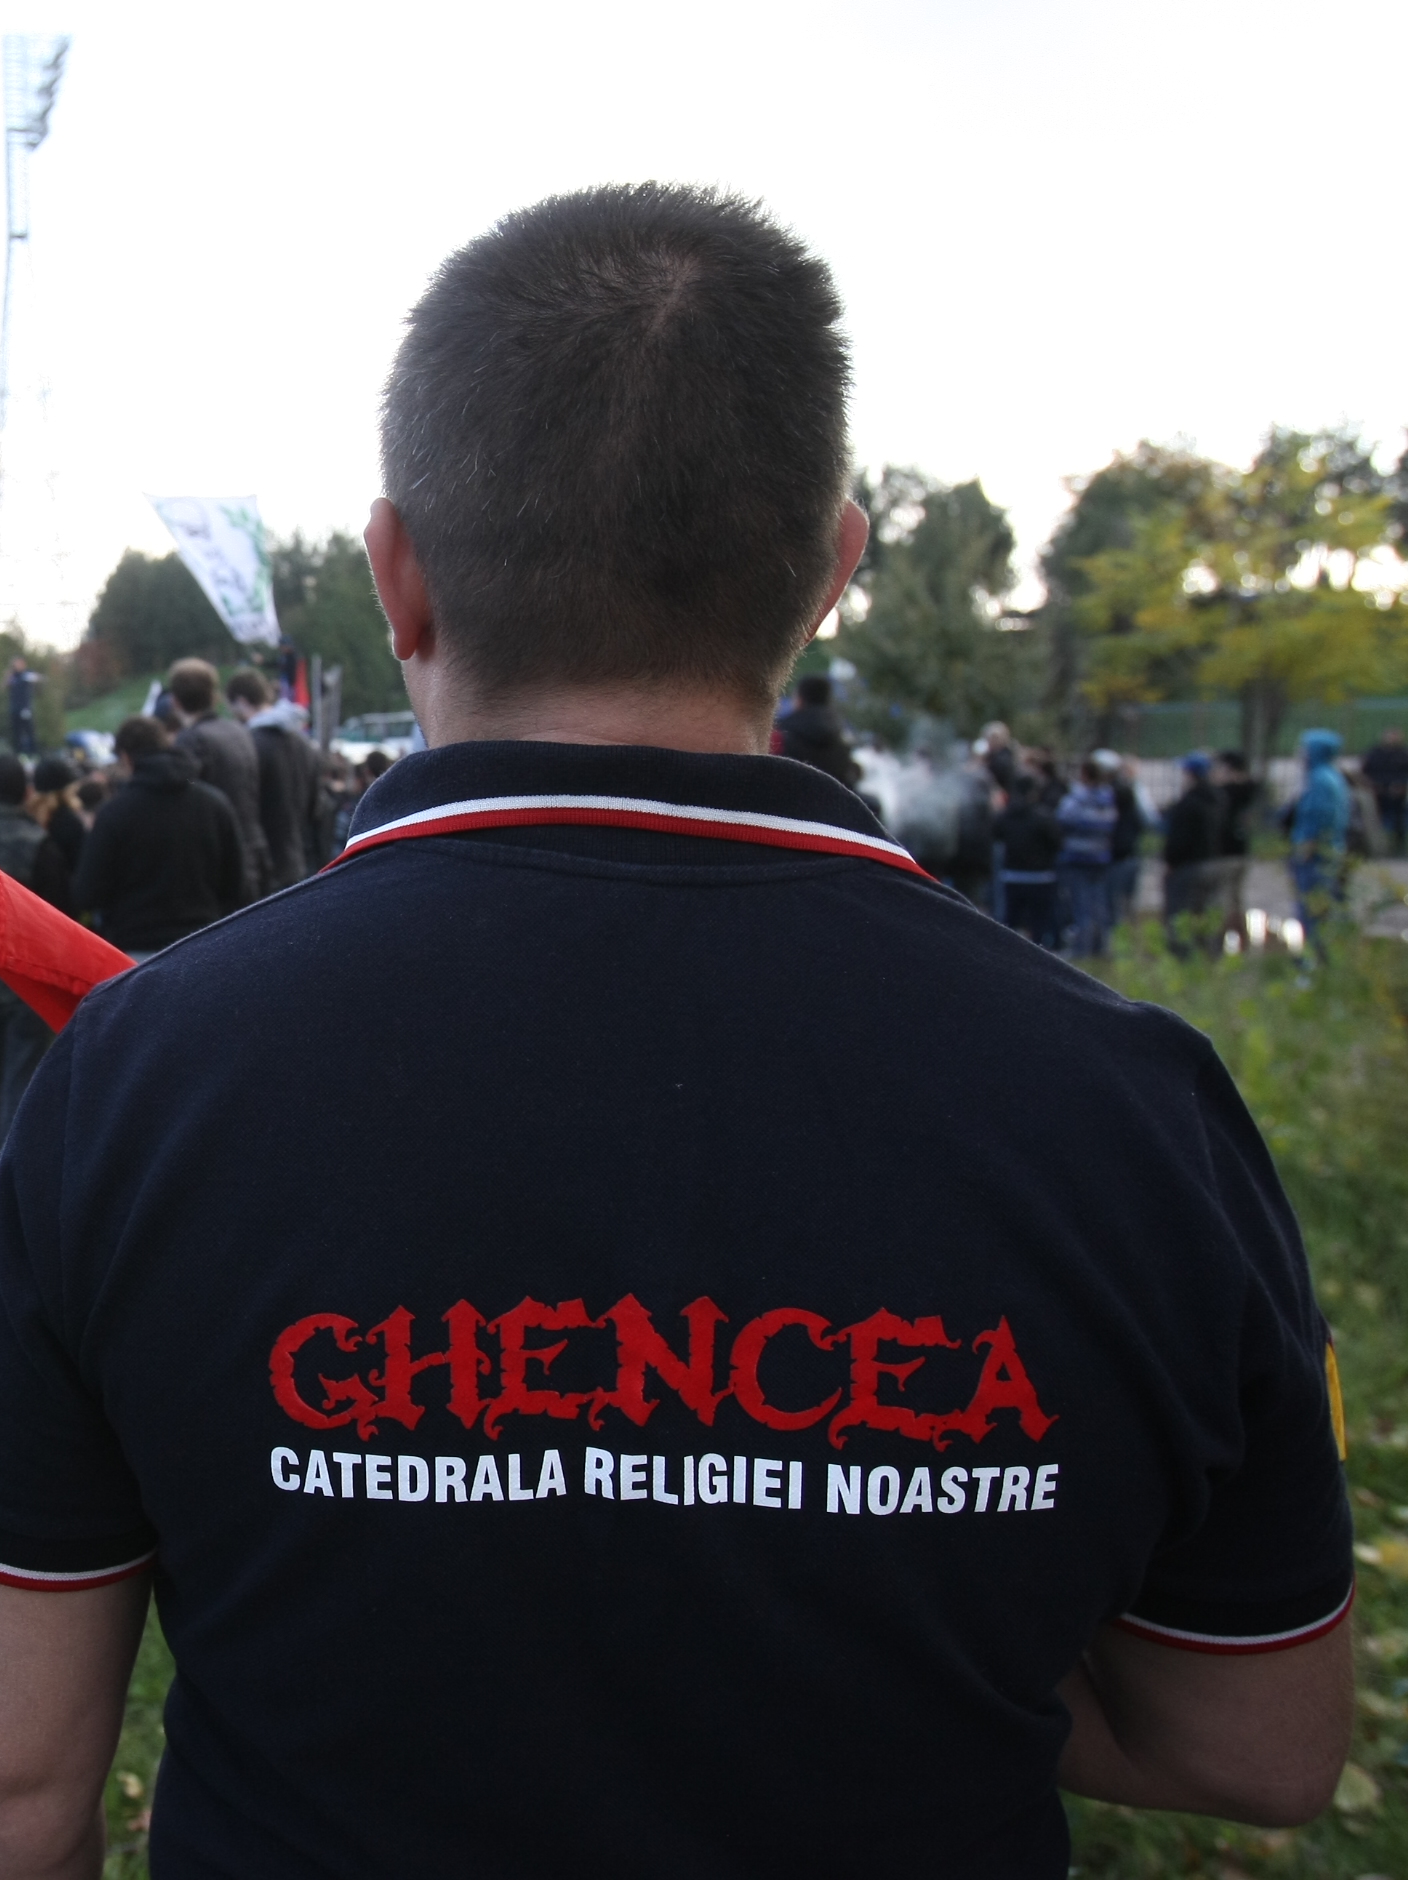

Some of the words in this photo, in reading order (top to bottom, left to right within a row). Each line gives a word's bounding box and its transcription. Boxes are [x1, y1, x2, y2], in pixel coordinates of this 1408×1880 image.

[269, 1293, 1059, 1452] GHENCEA
[269, 1446, 567, 1503] CATEDRALA
[584, 1446, 803, 1510] RELIGIEI
[826, 1463, 1059, 1516] NOASTRE
